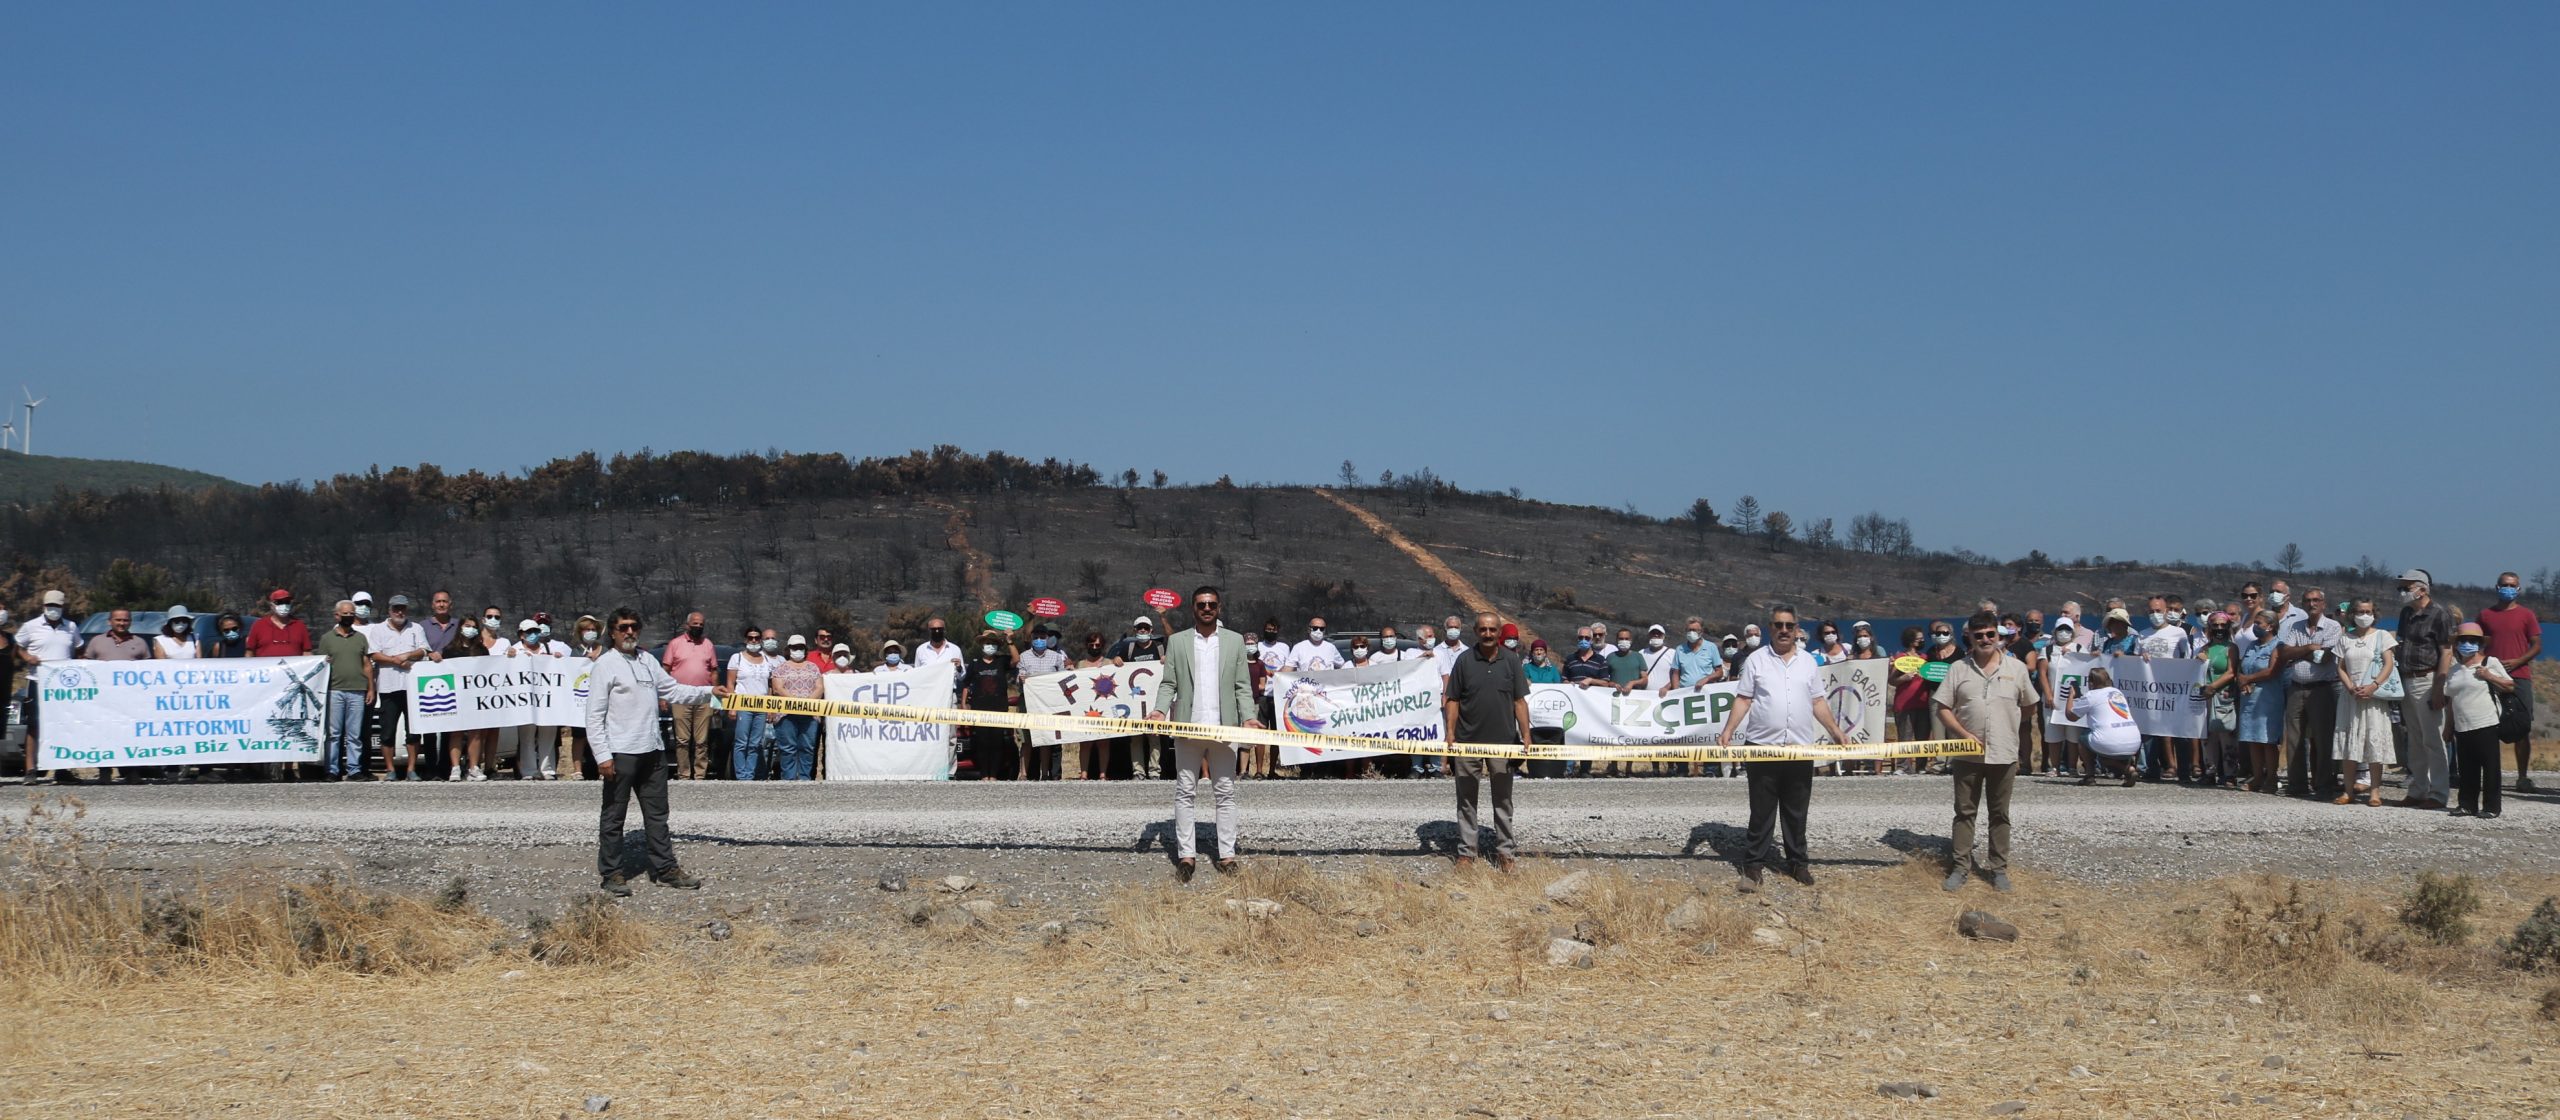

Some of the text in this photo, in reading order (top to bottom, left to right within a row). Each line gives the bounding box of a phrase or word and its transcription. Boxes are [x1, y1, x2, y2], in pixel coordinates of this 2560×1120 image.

[113, 671, 167, 691] FOÇA
[174, 670, 239, 690] ÇEVRE
[247, 669, 271, 684] VE
[462, 671, 565, 691] FOÇA KENT
[1851, 669, 1880, 707] BARIŞ
[2118, 679, 2140, 691] KENT
[2142, 681, 2190, 695] KONSEYİ
[44, 688, 99, 703] FOÇEP
[156, 690, 231, 711] KÜLTÜR
[852, 682, 910, 704] CHP
[1330, 691, 1432, 728] SAVUNUYORUZ
[1611, 691, 1736, 734] İZÇEP
[2133, 698, 2175, 712] MECLİSİ
[135, 719, 251, 737] PLATFORMU
[740, 695, 764, 709] İKLİM
[766, 699, 782, 713] SUÇ
[784, 699, 820, 713] MAHALLİ
[838, 704, 860, 716] İKLİM
[863, 705, 879, 719] SUÇ
[1325, 735, 1348, 747] İKLİM
[1369, 740, 1404, 751] MAHALLİ
[1706, 747, 1729, 758] İKLİM
[1732, 749, 1747, 760] SUÇ
[1898, 743, 1920, 754] İKLİM
[1923, 743, 1940, 756] SUÇ
[1942, 742, 1977, 753] MAHALLİ
[838, 722, 940, 742] KADIN KOLLARI
[1588, 732, 1613, 744] İzmir
[50, 745, 115, 763] "Doğa
[124, 744, 187, 759] Varsa
[194, 740, 229, 754] Biz
